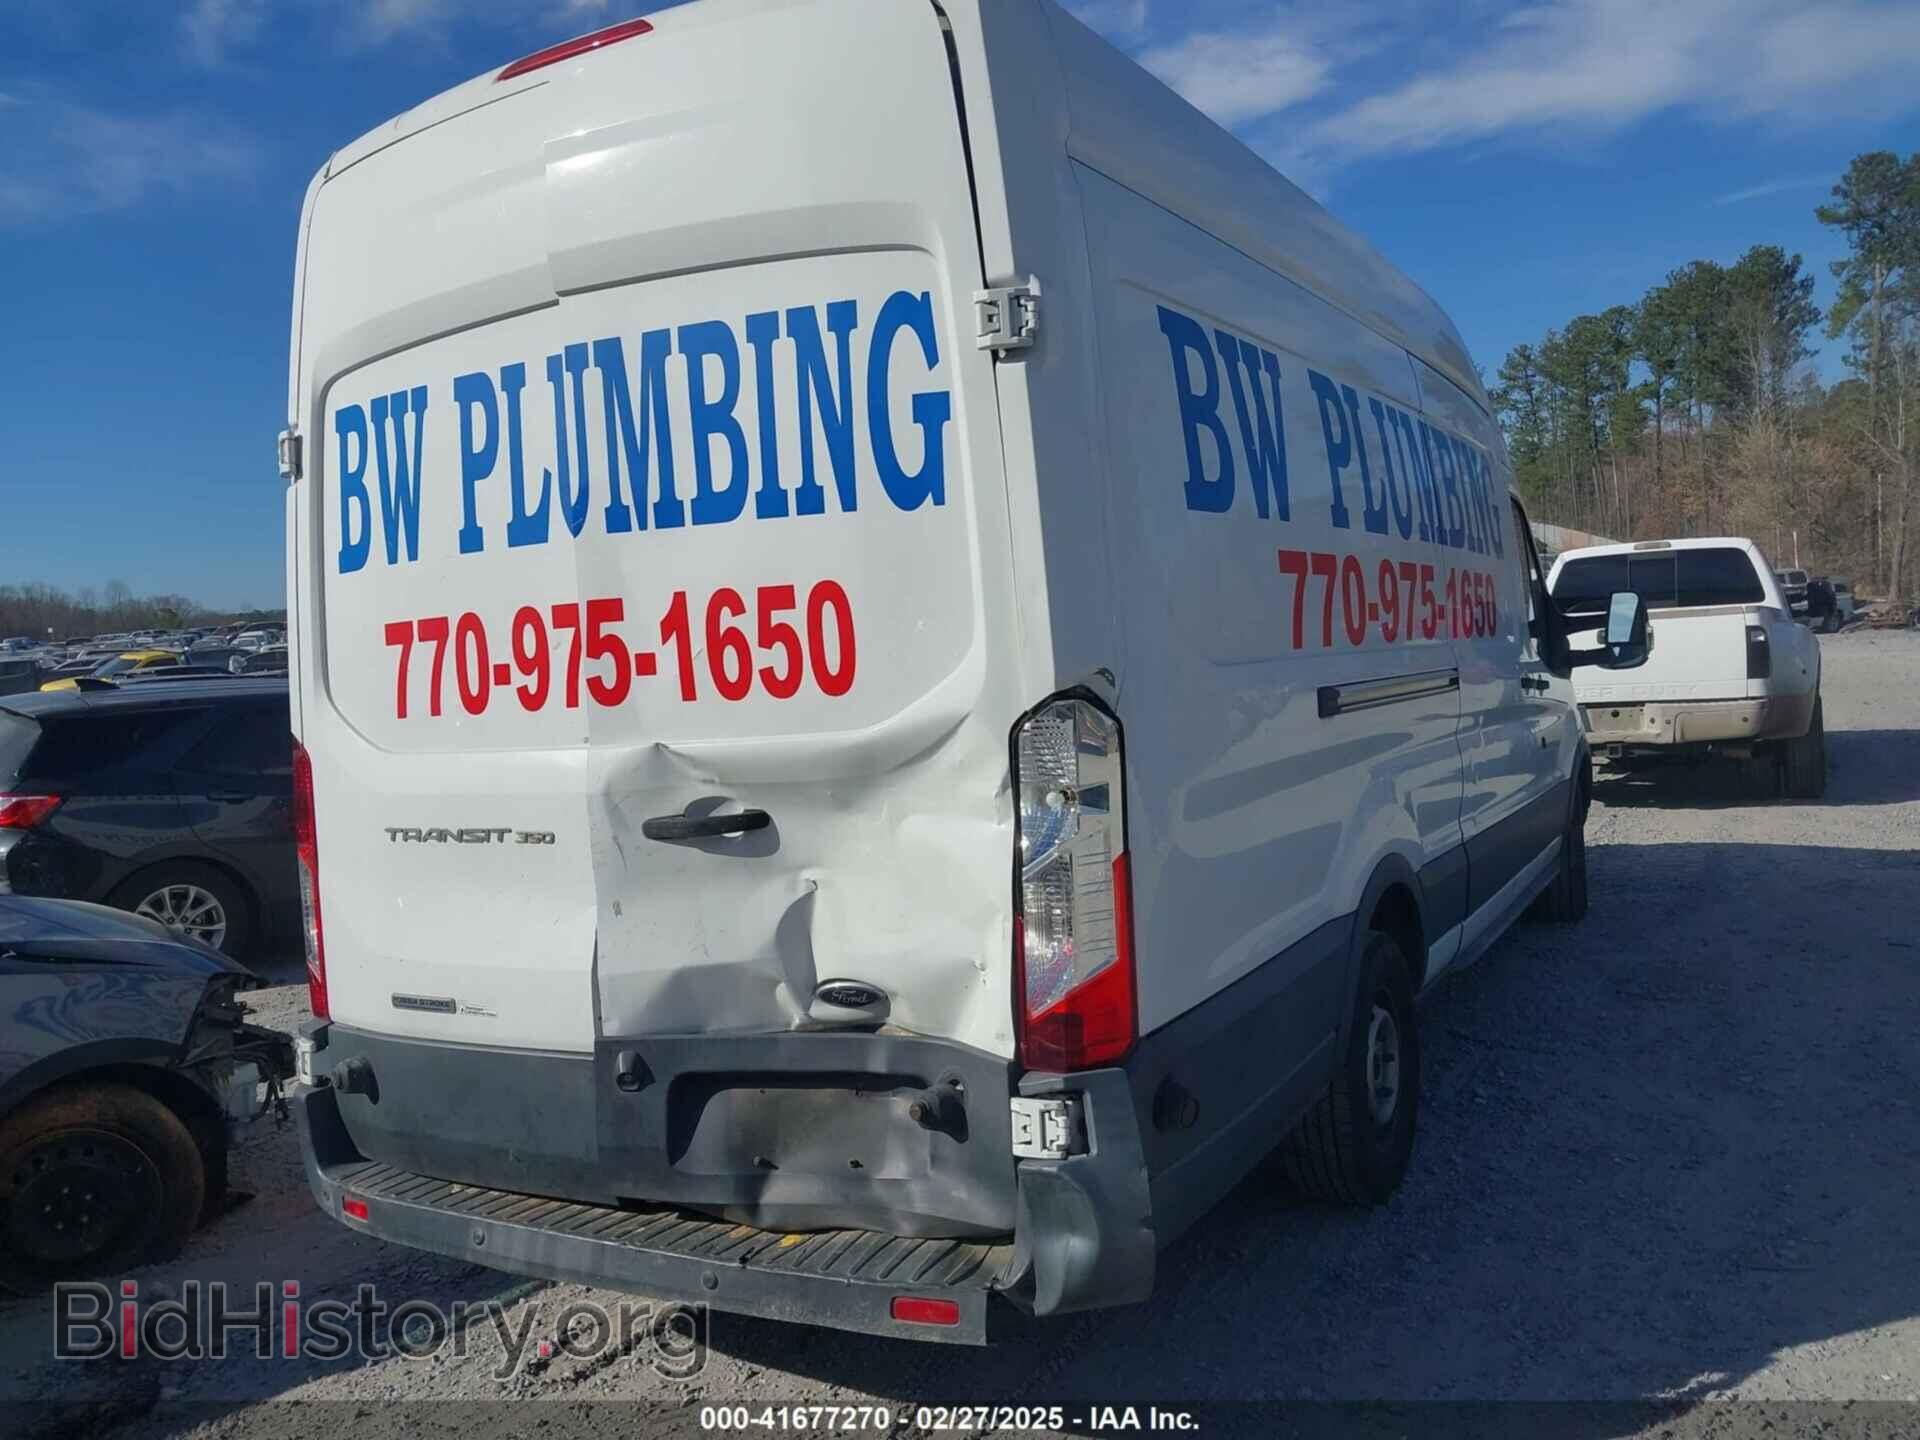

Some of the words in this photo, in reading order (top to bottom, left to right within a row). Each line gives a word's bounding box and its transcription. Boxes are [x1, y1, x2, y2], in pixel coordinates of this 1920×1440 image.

[334, 384, 429, 576] BW
[452, 289, 952, 555] PLUMBING
[1156, 304, 1290, 522] BW
[1306, 368, 1504, 559] PLUMBING
[384, 579, 858, 720] 770-975-1650
[1278, 549, 1497, 650] 770-975-1650
[384, 827, 512, 844] TRANSIT
[515, 831, 556, 845] 350
[831, 988, 869, 1004] Ford
